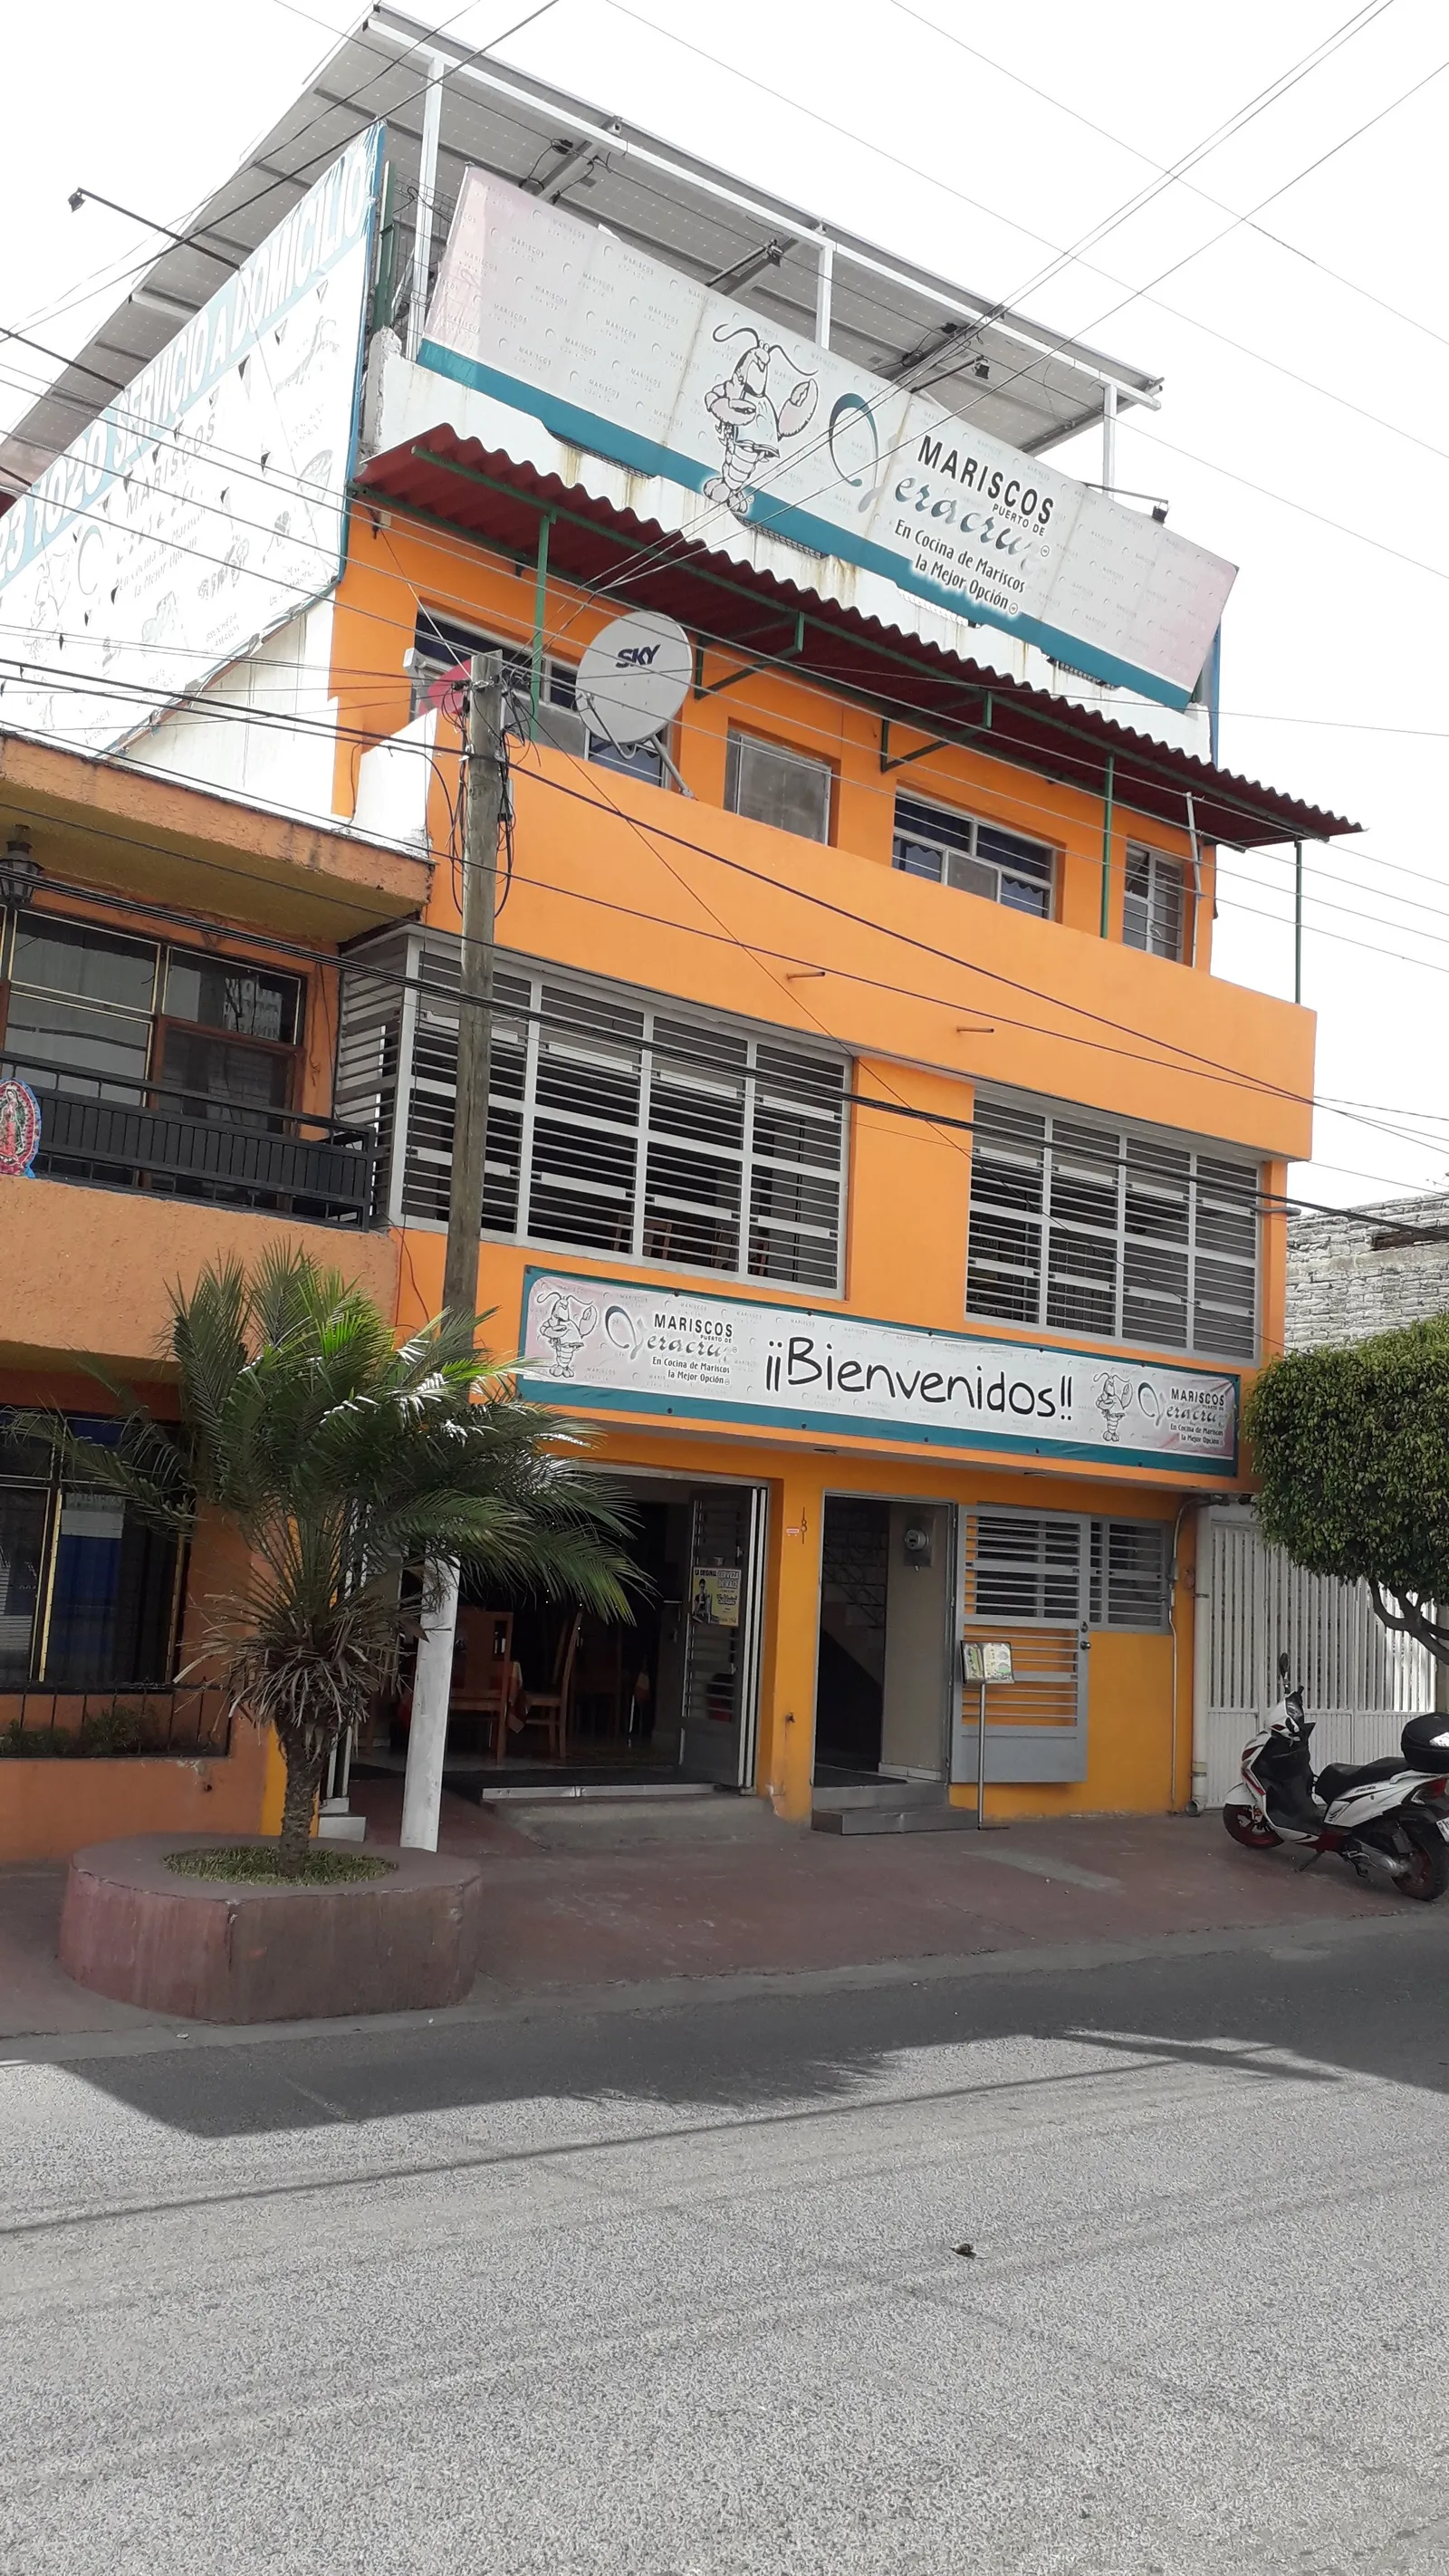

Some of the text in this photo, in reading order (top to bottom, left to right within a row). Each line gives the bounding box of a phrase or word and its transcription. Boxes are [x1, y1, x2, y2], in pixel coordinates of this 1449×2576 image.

[230, 141, 366, 354] DOMICILIO
[916, 435, 1054, 525] MARISCOS
[992, 503, 1046, 537] PUERTO DE
[894, 519, 1025, 594] En Cocina de Mariscos
[914, 553, 927, 572] la
[930, 562, 967, 591] Mejor
[968, 580, 1009, 610] Opción
[615, 644, 661, 668] SKY
[654, 1313, 734, 1338] MARISCOS
[700, 1334, 723, 1342] PUERTO
[652, 1356, 730, 1374] En Cocina de Mariscos
[667, 1370, 724, 1385] la Mejor Opción
[766, 1337, 1072, 1421] ¡¡Bienvenidos!!
[1171, 1388, 1224, 1407] MARISCOS
